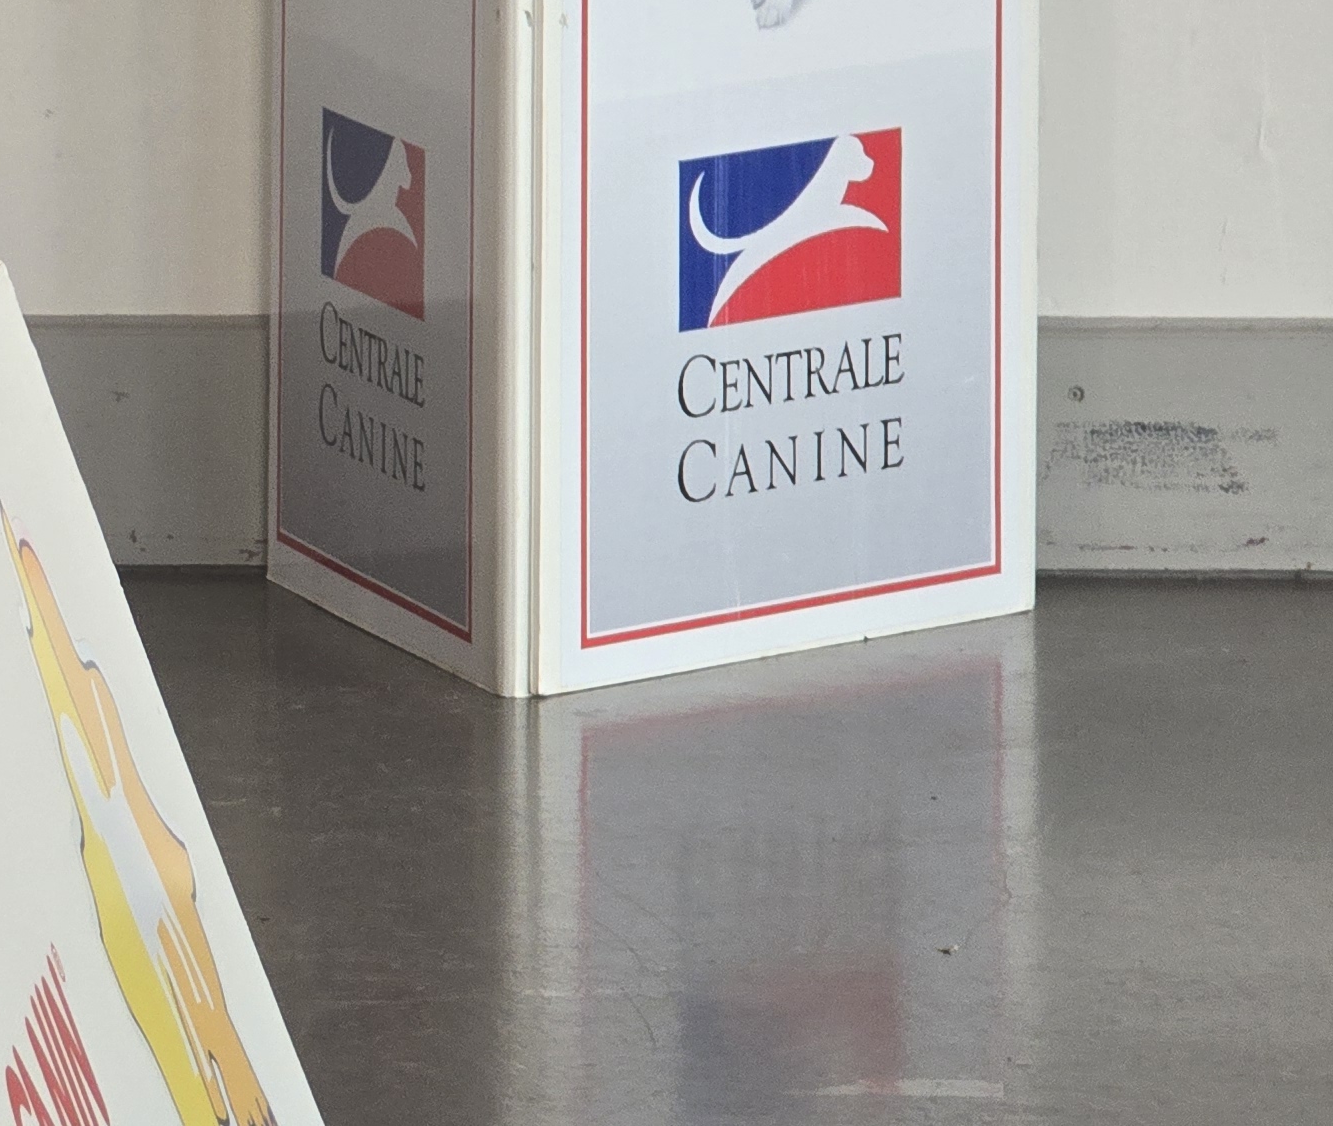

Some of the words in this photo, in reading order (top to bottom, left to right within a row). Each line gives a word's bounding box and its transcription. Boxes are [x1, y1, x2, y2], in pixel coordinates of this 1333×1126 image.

[319, 300, 426, 409] CENTRALE
[677, 332, 906, 419] CENTRALE
[318, 383, 426, 493] CANINE
[677, 416, 905, 503] CANINE
